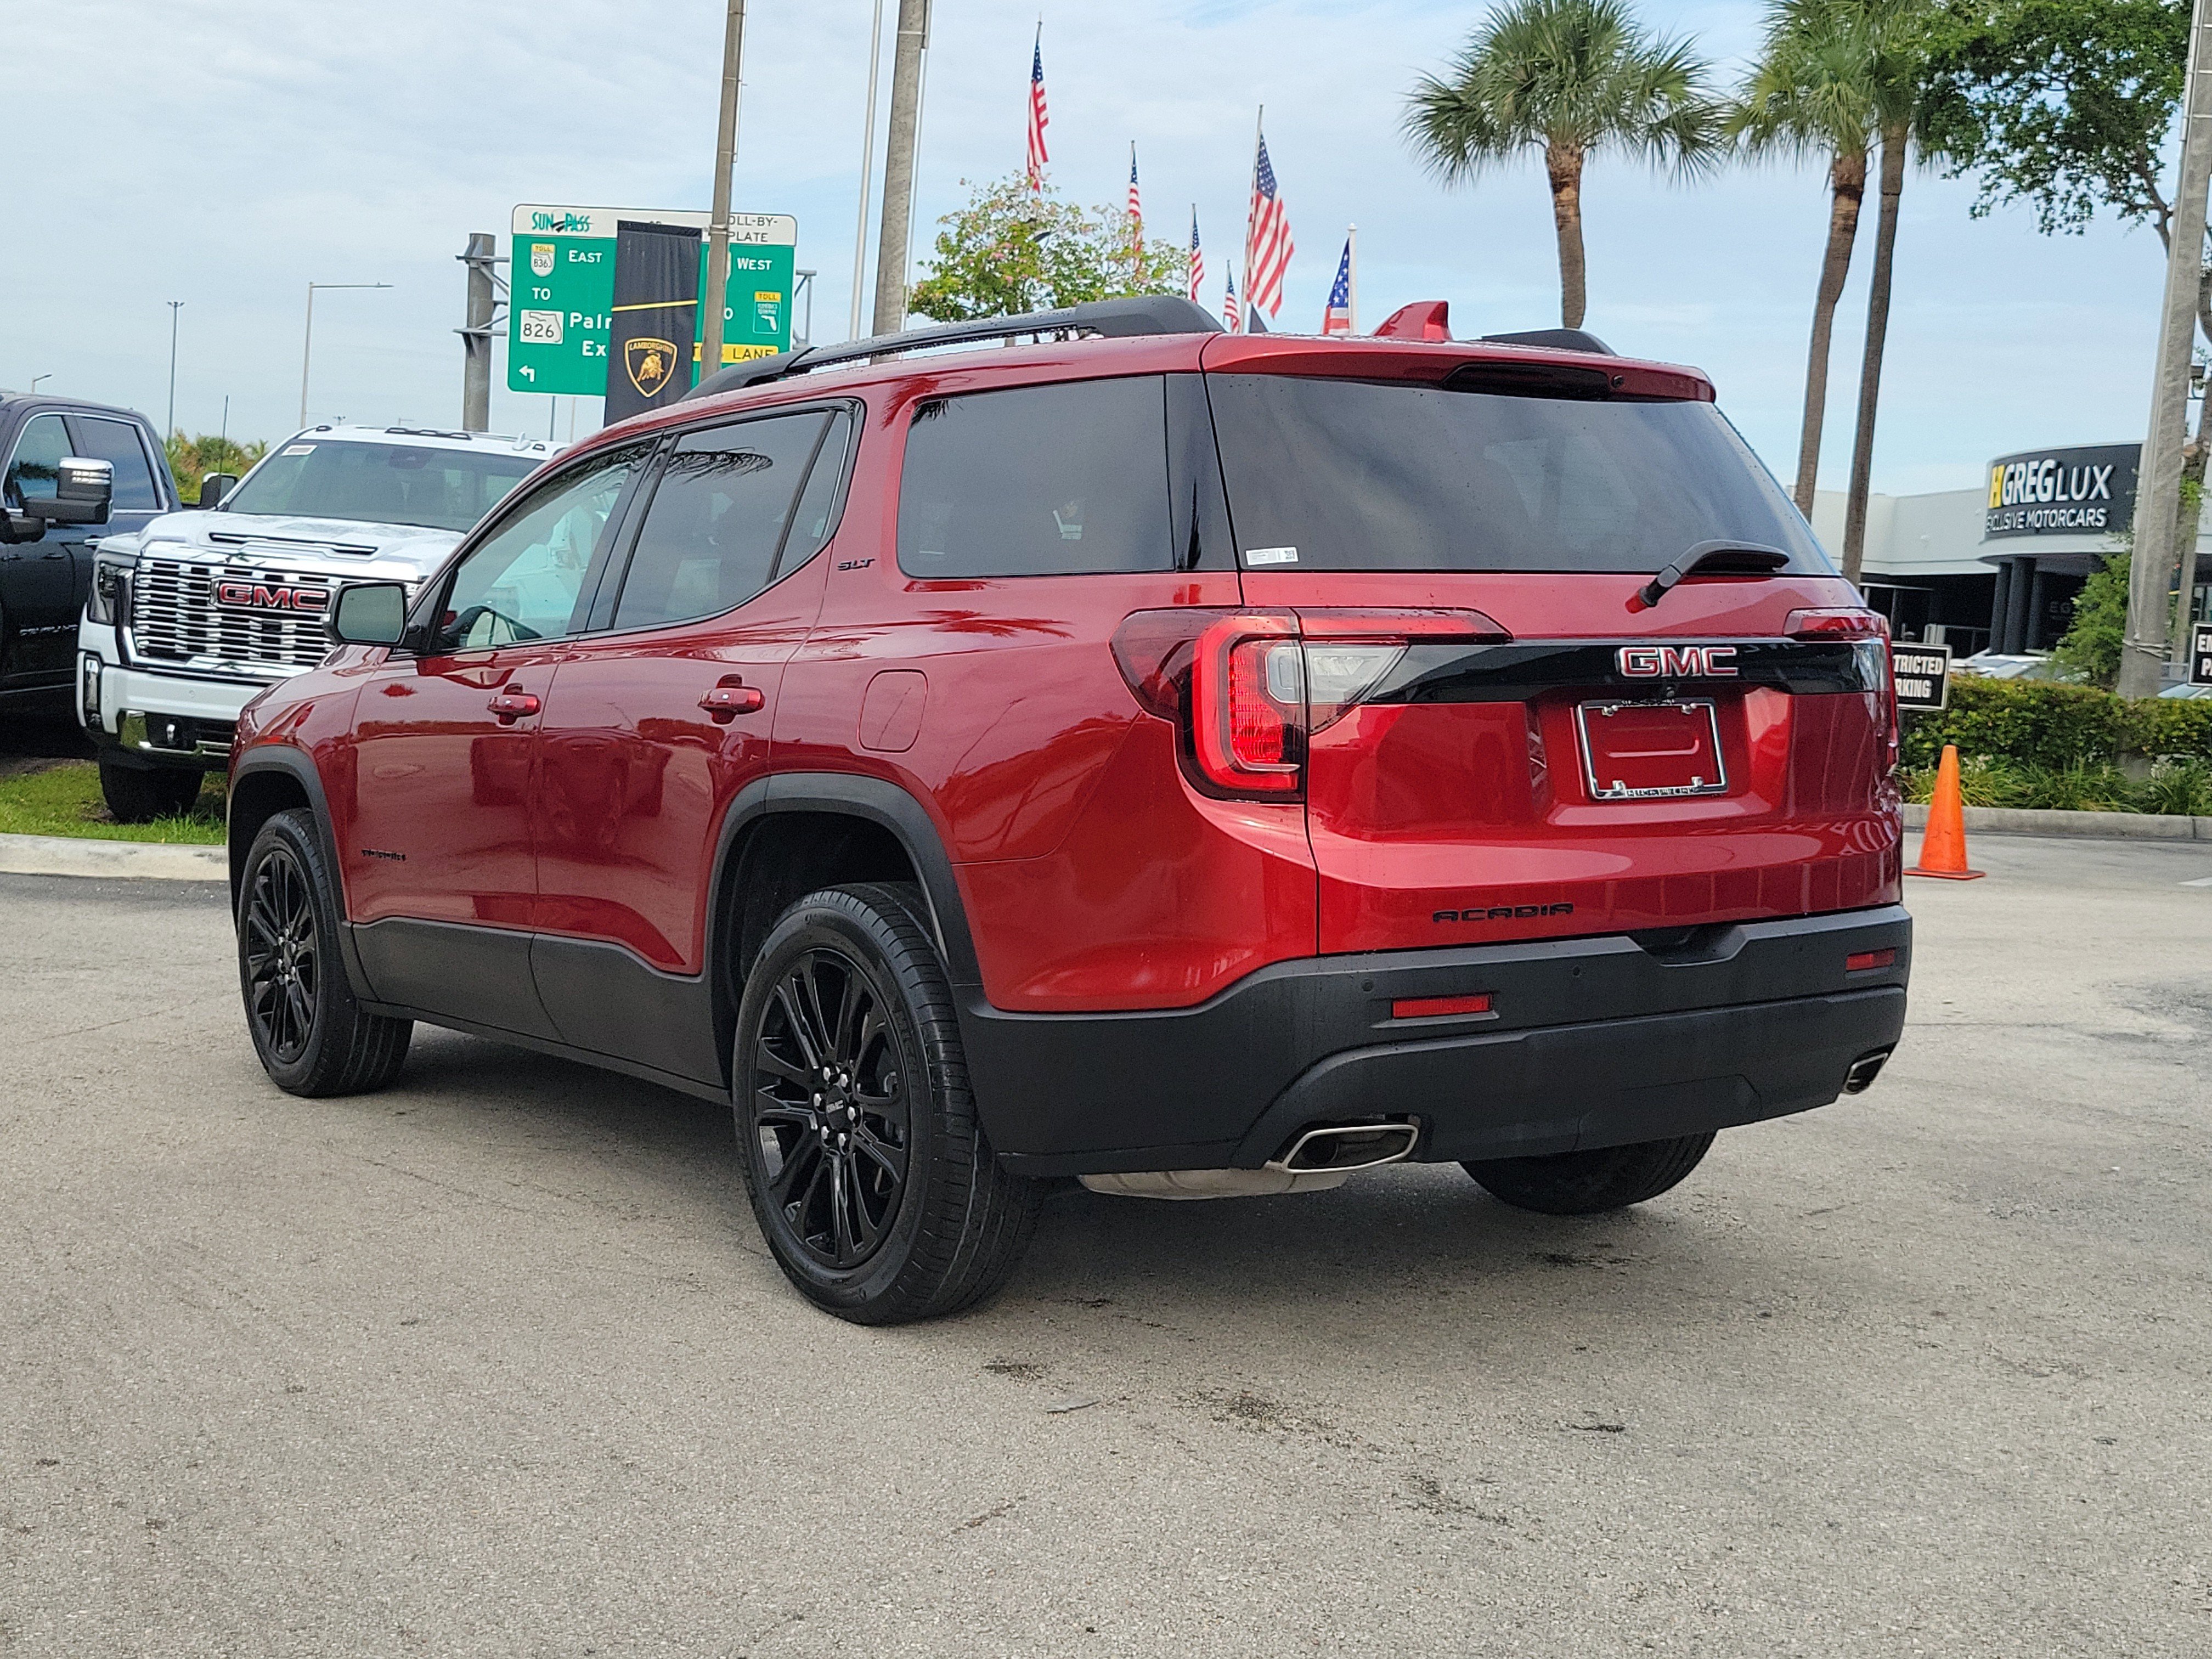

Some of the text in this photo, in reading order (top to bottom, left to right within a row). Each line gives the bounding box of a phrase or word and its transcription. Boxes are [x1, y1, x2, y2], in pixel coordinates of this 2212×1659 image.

[532, 212, 590, 232] SUN PASS
[729, 216, 777, 227] OLL-BY-
[729, 232, 768, 242] PLATE
[737, 258, 772, 270] WEST
[532, 287, 551, 301] TO
[523, 323, 554, 338] 826
[2025, 507, 2108, 528] MOTORCARS
[837, 558, 876, 571] SLT
[219, 583, 326, 611] GMC
[1618, 647, 1739, 677] GMC
[1892, 654, 1944, 675] TRICTED
[1895, 678, 1932, 698] RKING
[1433, 902, 1573, 923] ACADIA
